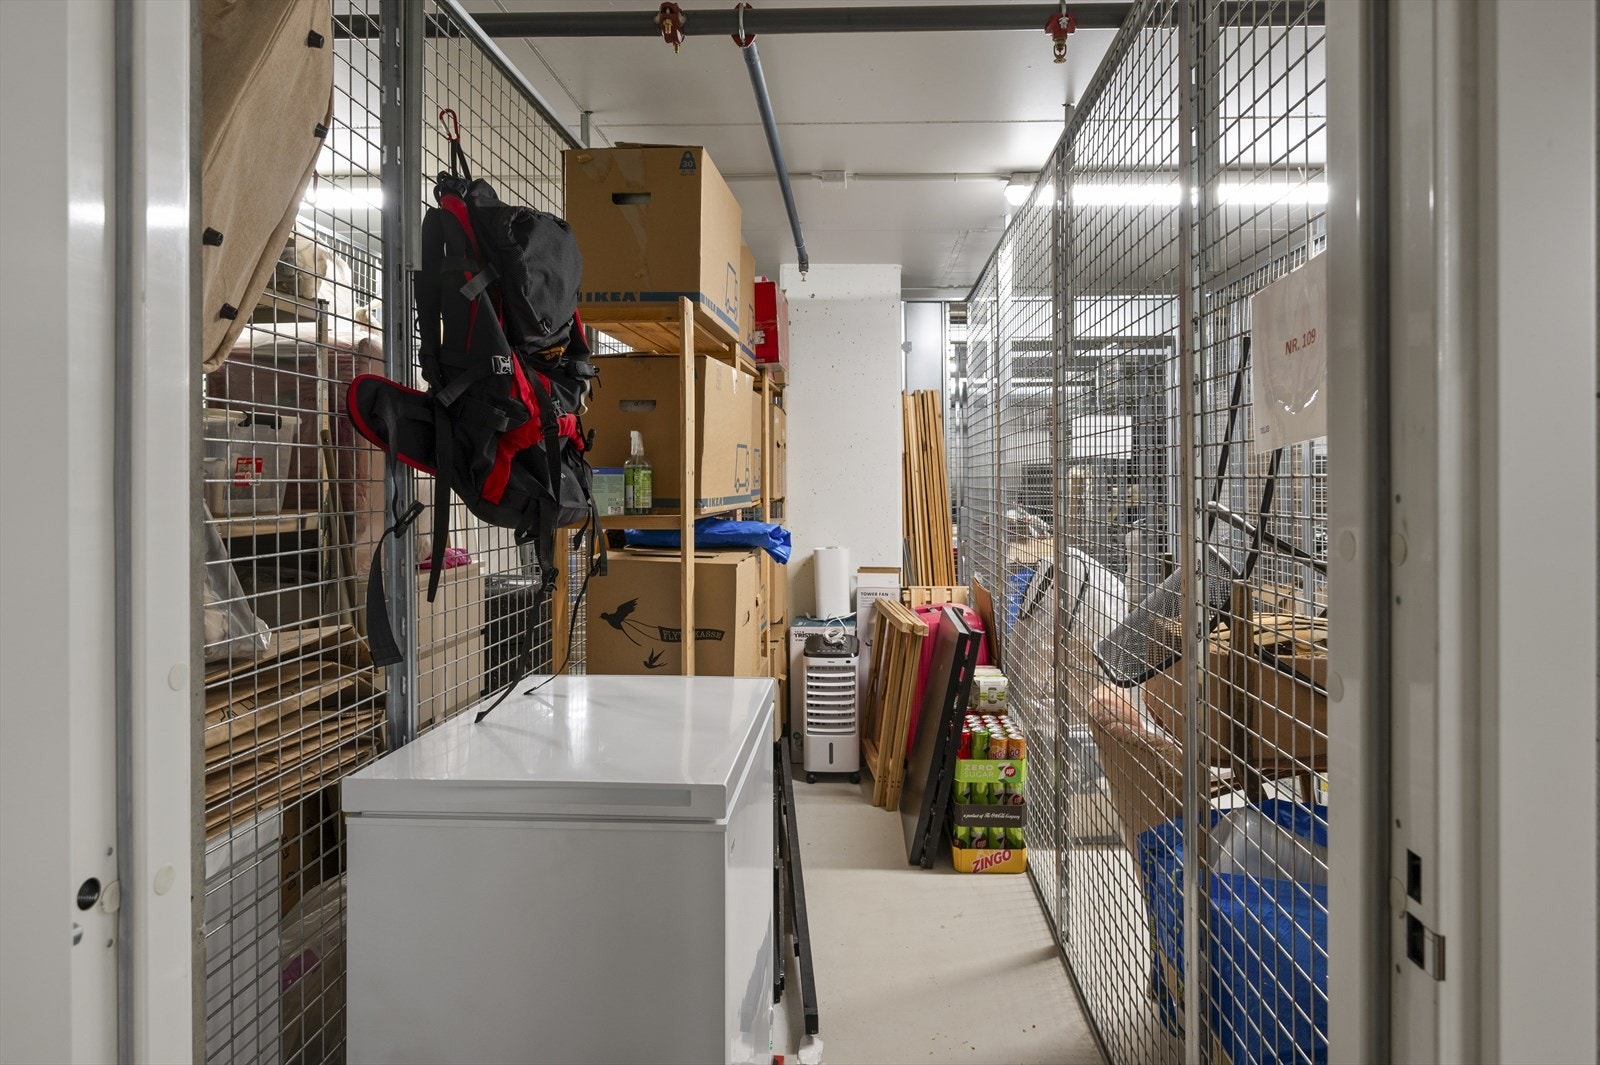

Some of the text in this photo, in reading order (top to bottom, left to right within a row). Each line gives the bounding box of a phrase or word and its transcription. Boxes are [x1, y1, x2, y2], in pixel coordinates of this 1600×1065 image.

[681, 160, 694, 168] 30
[586, 291, 637, 302] IKEA
[705, 295, 718, 314] IKEA
[1285, 327, 1316, 355] NR. 109
[708, 496, 724, 507] IKEA
[963, 763, 994, 771] ZERO
[963, 770, 994, 778] SUGAR
[971, 849, 1012, 873] ZINGO
